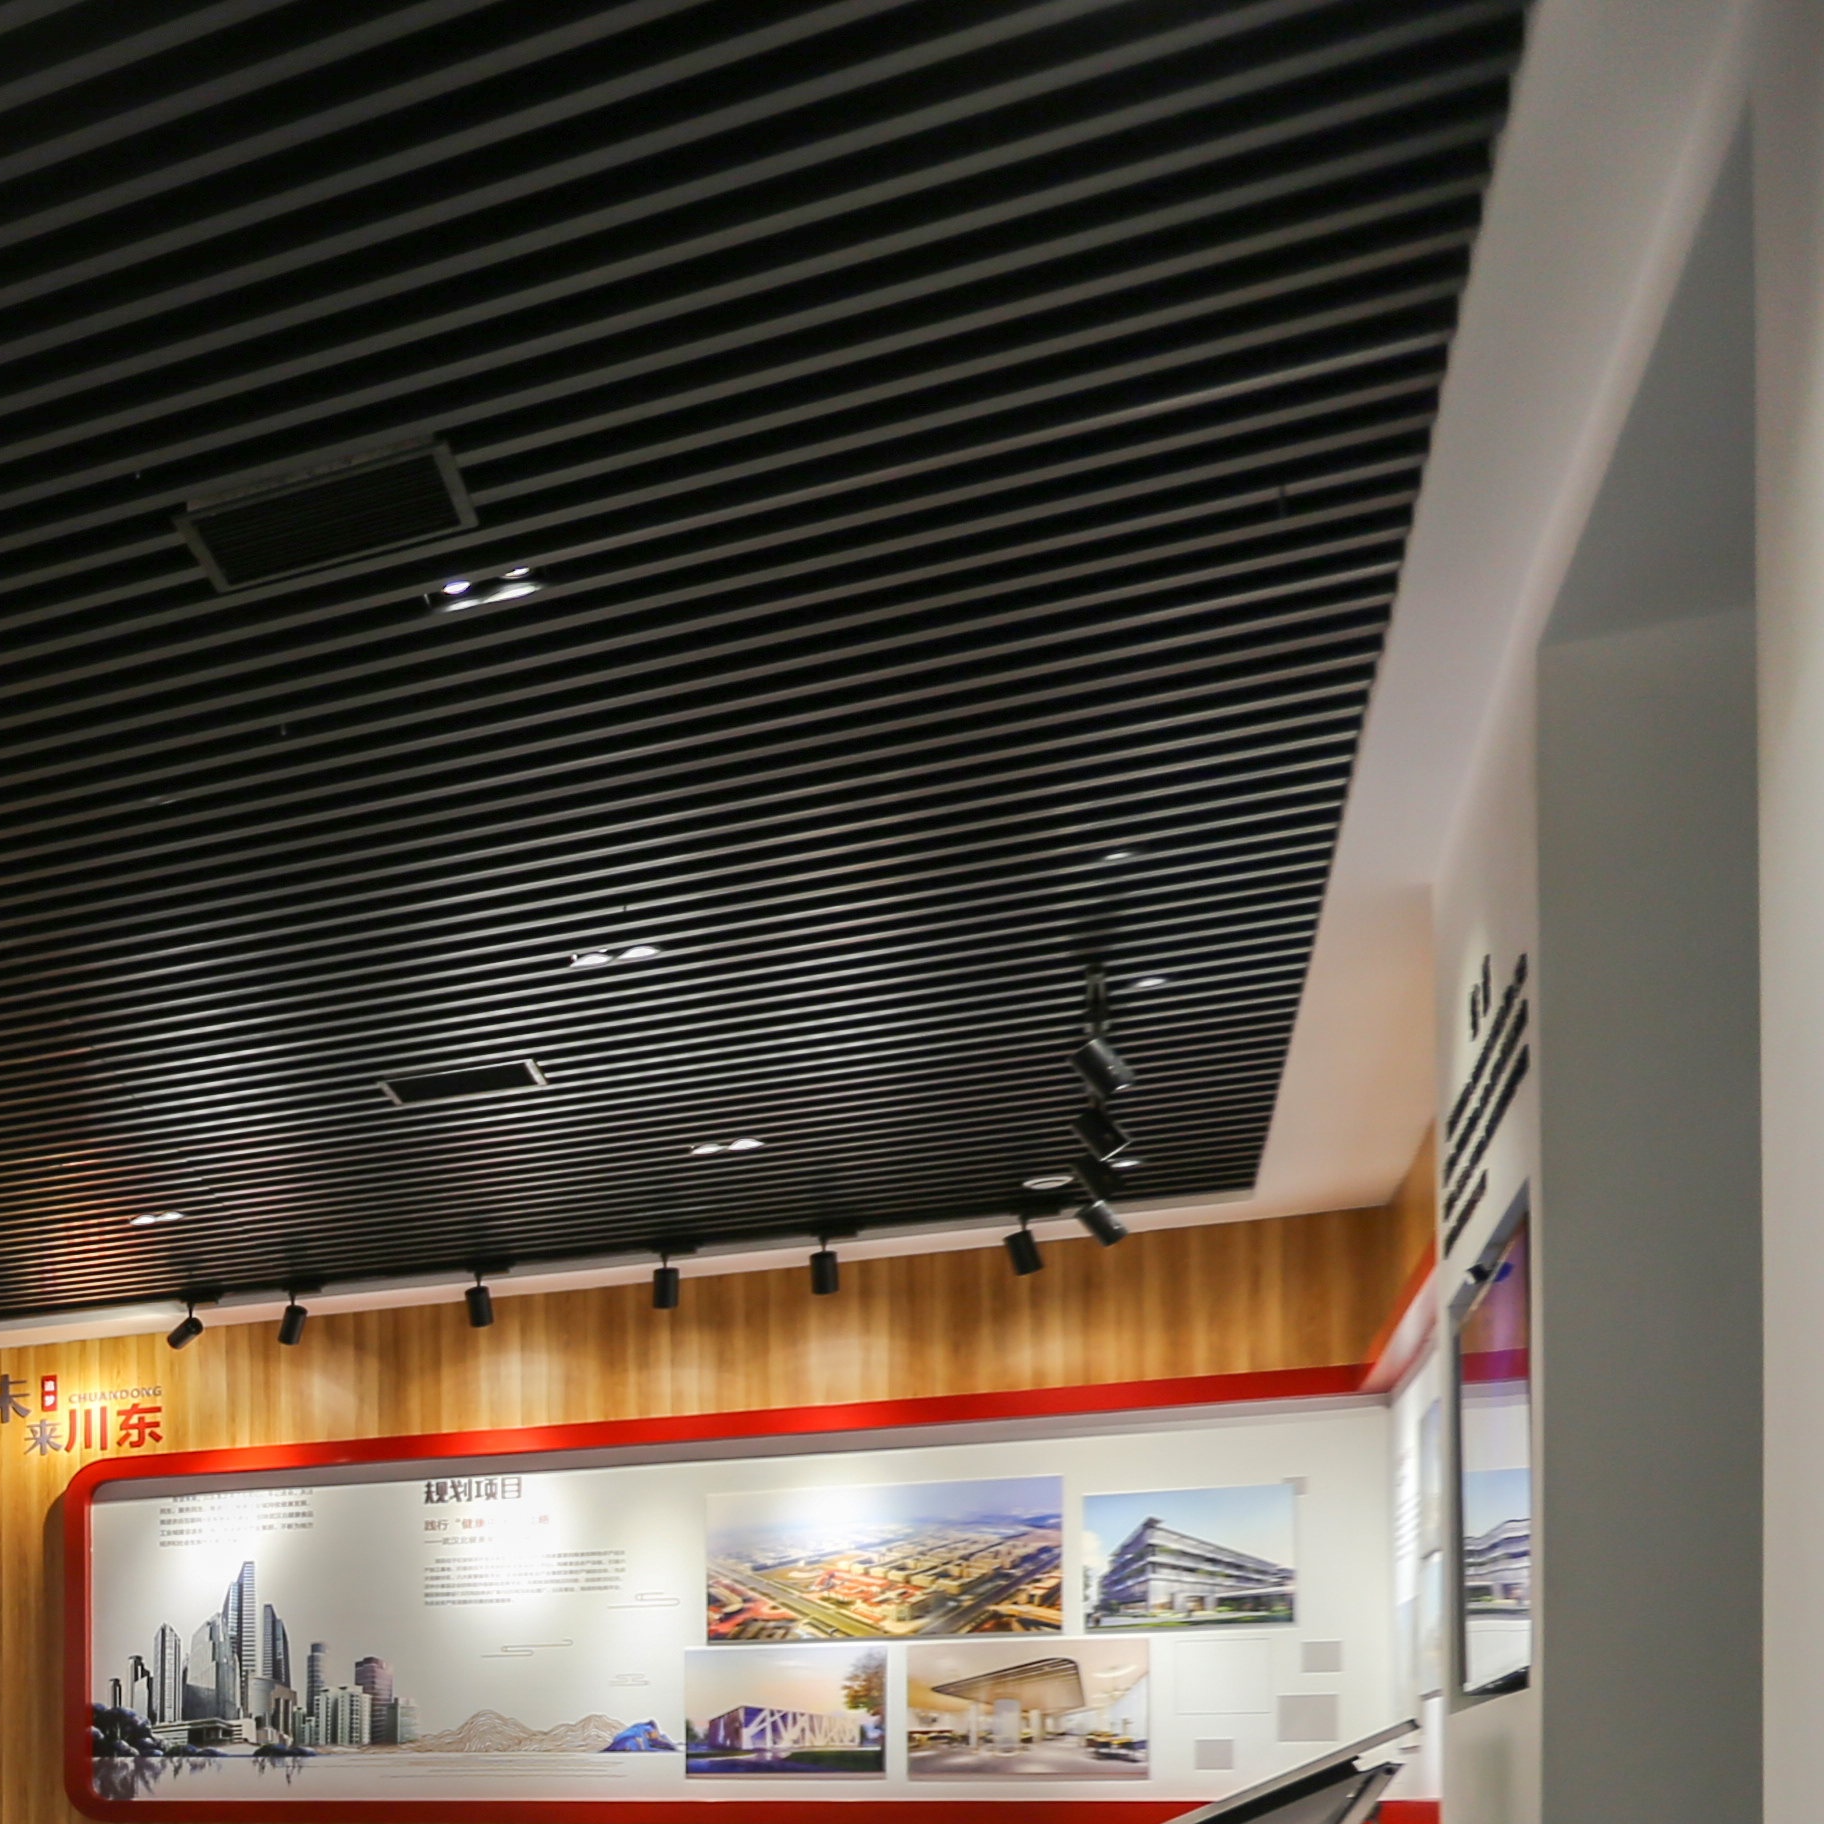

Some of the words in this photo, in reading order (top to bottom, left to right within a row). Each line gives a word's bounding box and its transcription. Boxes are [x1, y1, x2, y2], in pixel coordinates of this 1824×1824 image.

[68, 1385, 163, 1404] CHUANDONG
[64, 1403, 164, 1453] 川东
[423, 1476, 522, 1505] 规划项目
